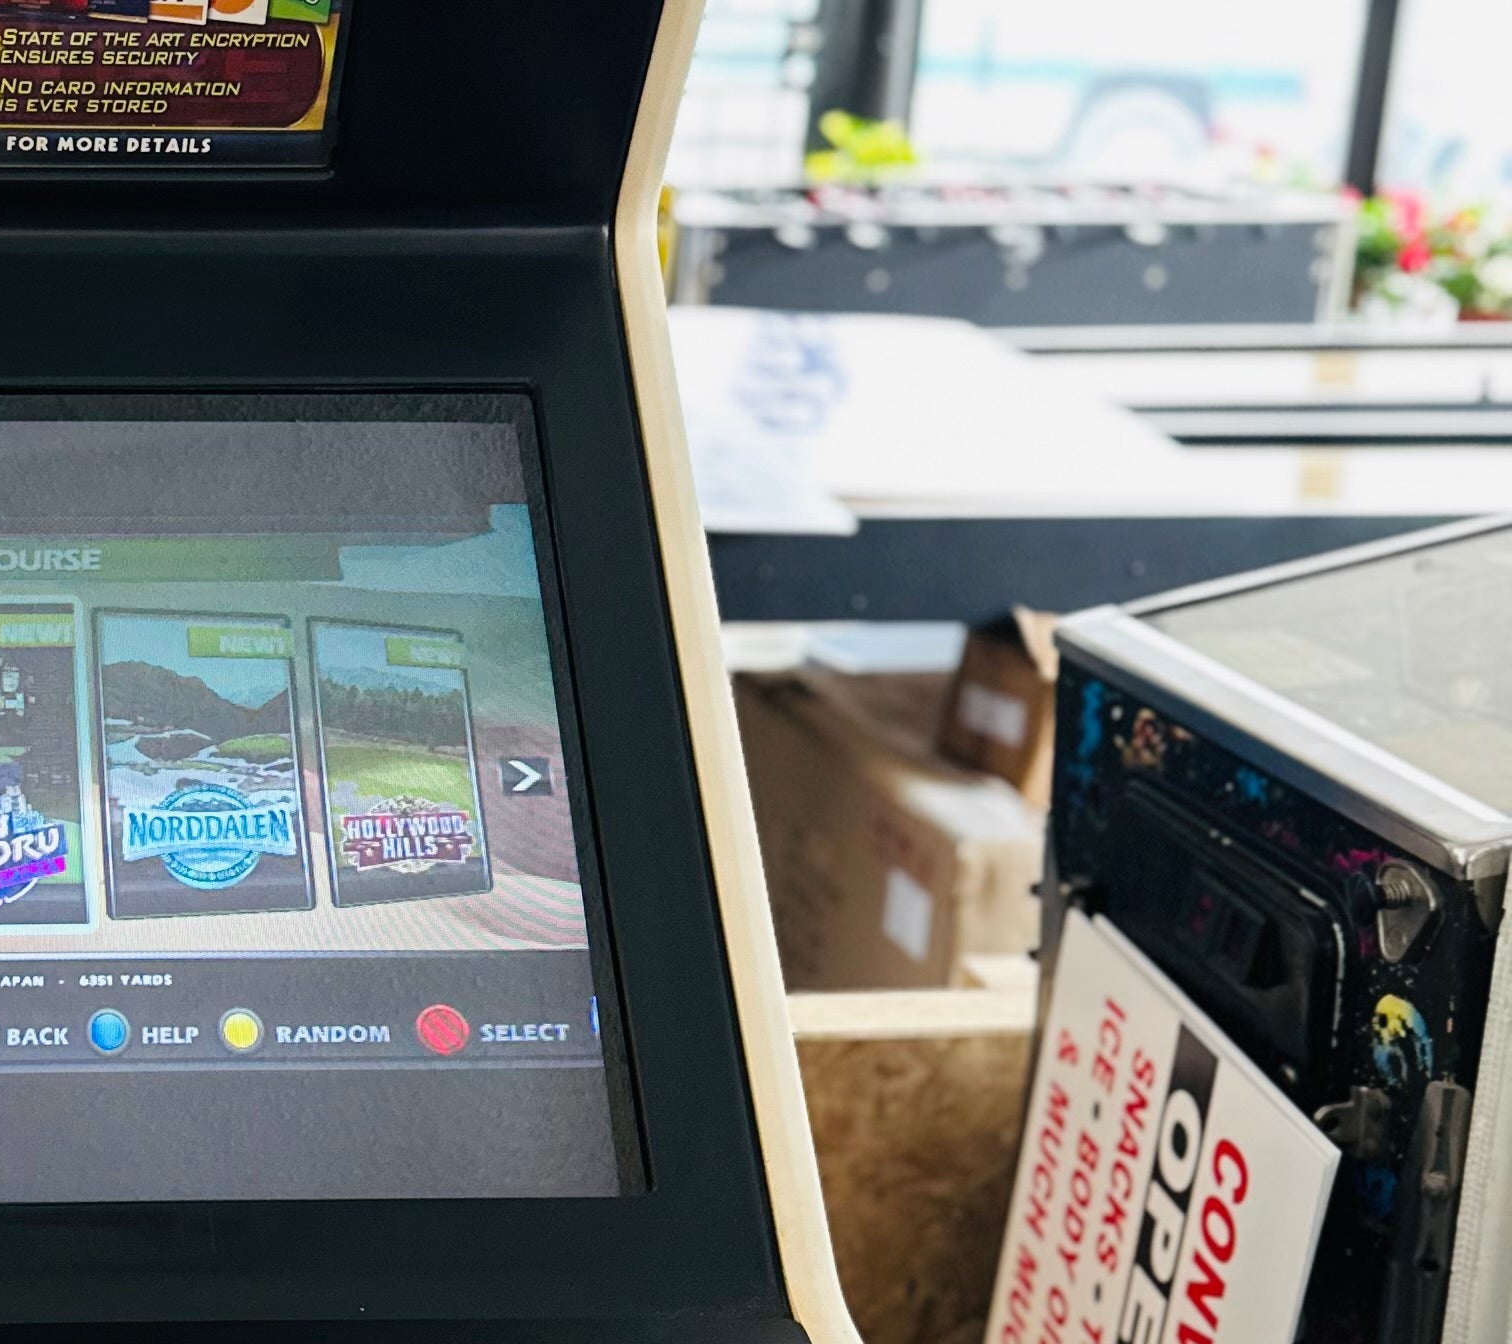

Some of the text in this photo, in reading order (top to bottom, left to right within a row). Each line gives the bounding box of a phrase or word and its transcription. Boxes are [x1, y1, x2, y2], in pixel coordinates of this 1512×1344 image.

[0, 28, 310, 48] STATE OF THE ART ENCRYPTION
[0, 49, 199, 66] ENSURES SECURITY
[0, 78, 241, 96] NO CARD INFORMATION
[0, 99, 168, 113] IS EVER STORED
[6, 136, 49, 151] FOR
[57, 136, 118, 153] MORE
[126, 137, 212, 154] DETAILS
[128, 808, 289, 846] NORDDALEN
[346, 814, 464, 840] HOLLYWOOD
[382, 835, 439, 860] HILLS
[121, 974, 173, 987] YARDS
[7, 1023, 570, 1046] BACK HELP RANDOM SELECT
[1090, 997, 1128, 1095] ICE
[1098, 1050, 1156, 1273] SNACKS
[1060, 1128, 1093, 1283] BODY
